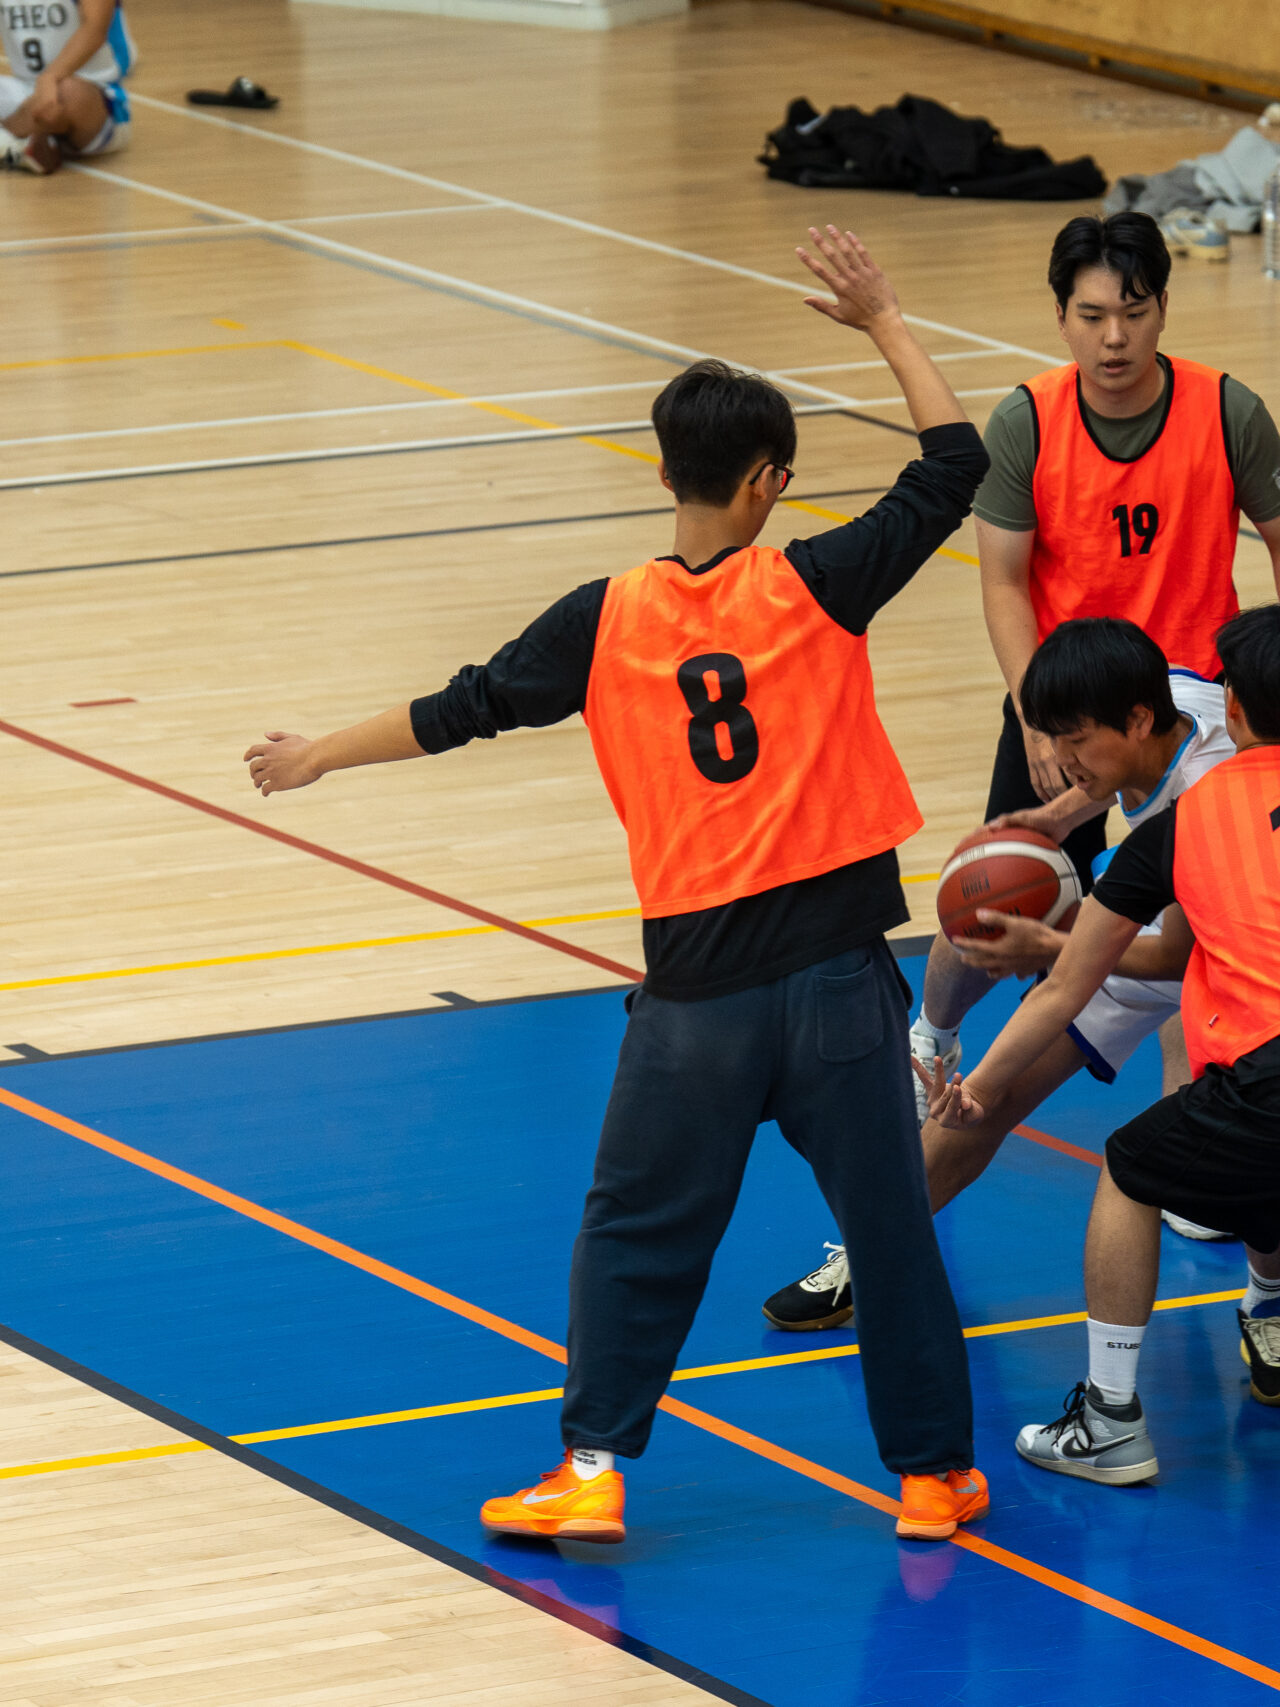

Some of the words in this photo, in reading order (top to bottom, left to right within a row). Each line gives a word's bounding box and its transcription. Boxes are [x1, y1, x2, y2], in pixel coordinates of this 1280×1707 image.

[0, 3, 68, 30] HEO
[22, 37, 45, 73] 9
[1112, 503, 1159, 558] 19
[677, 652, 759, 784] 8
